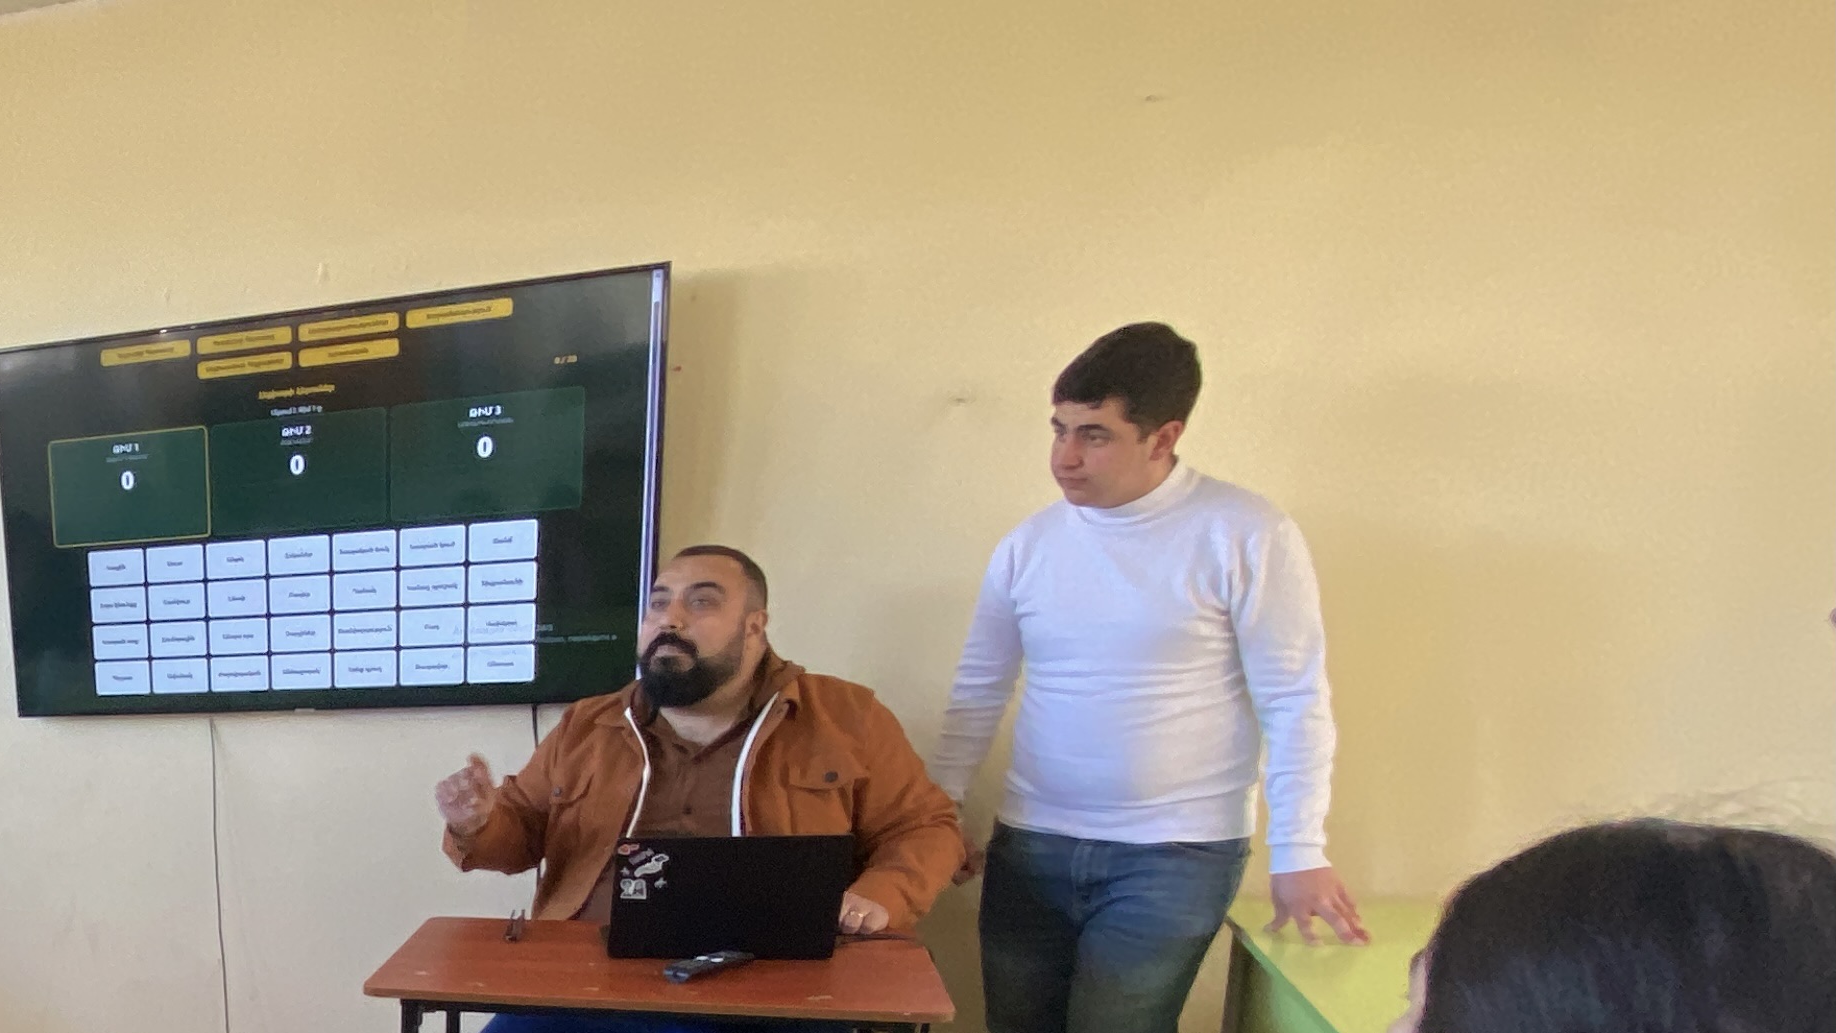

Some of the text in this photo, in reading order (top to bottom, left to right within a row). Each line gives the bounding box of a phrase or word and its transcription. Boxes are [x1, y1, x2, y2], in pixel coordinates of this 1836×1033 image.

[476, 435, 493, 458] 0
[289, 454, 305, 476] 0
[121, 470, 135, 490] 0
